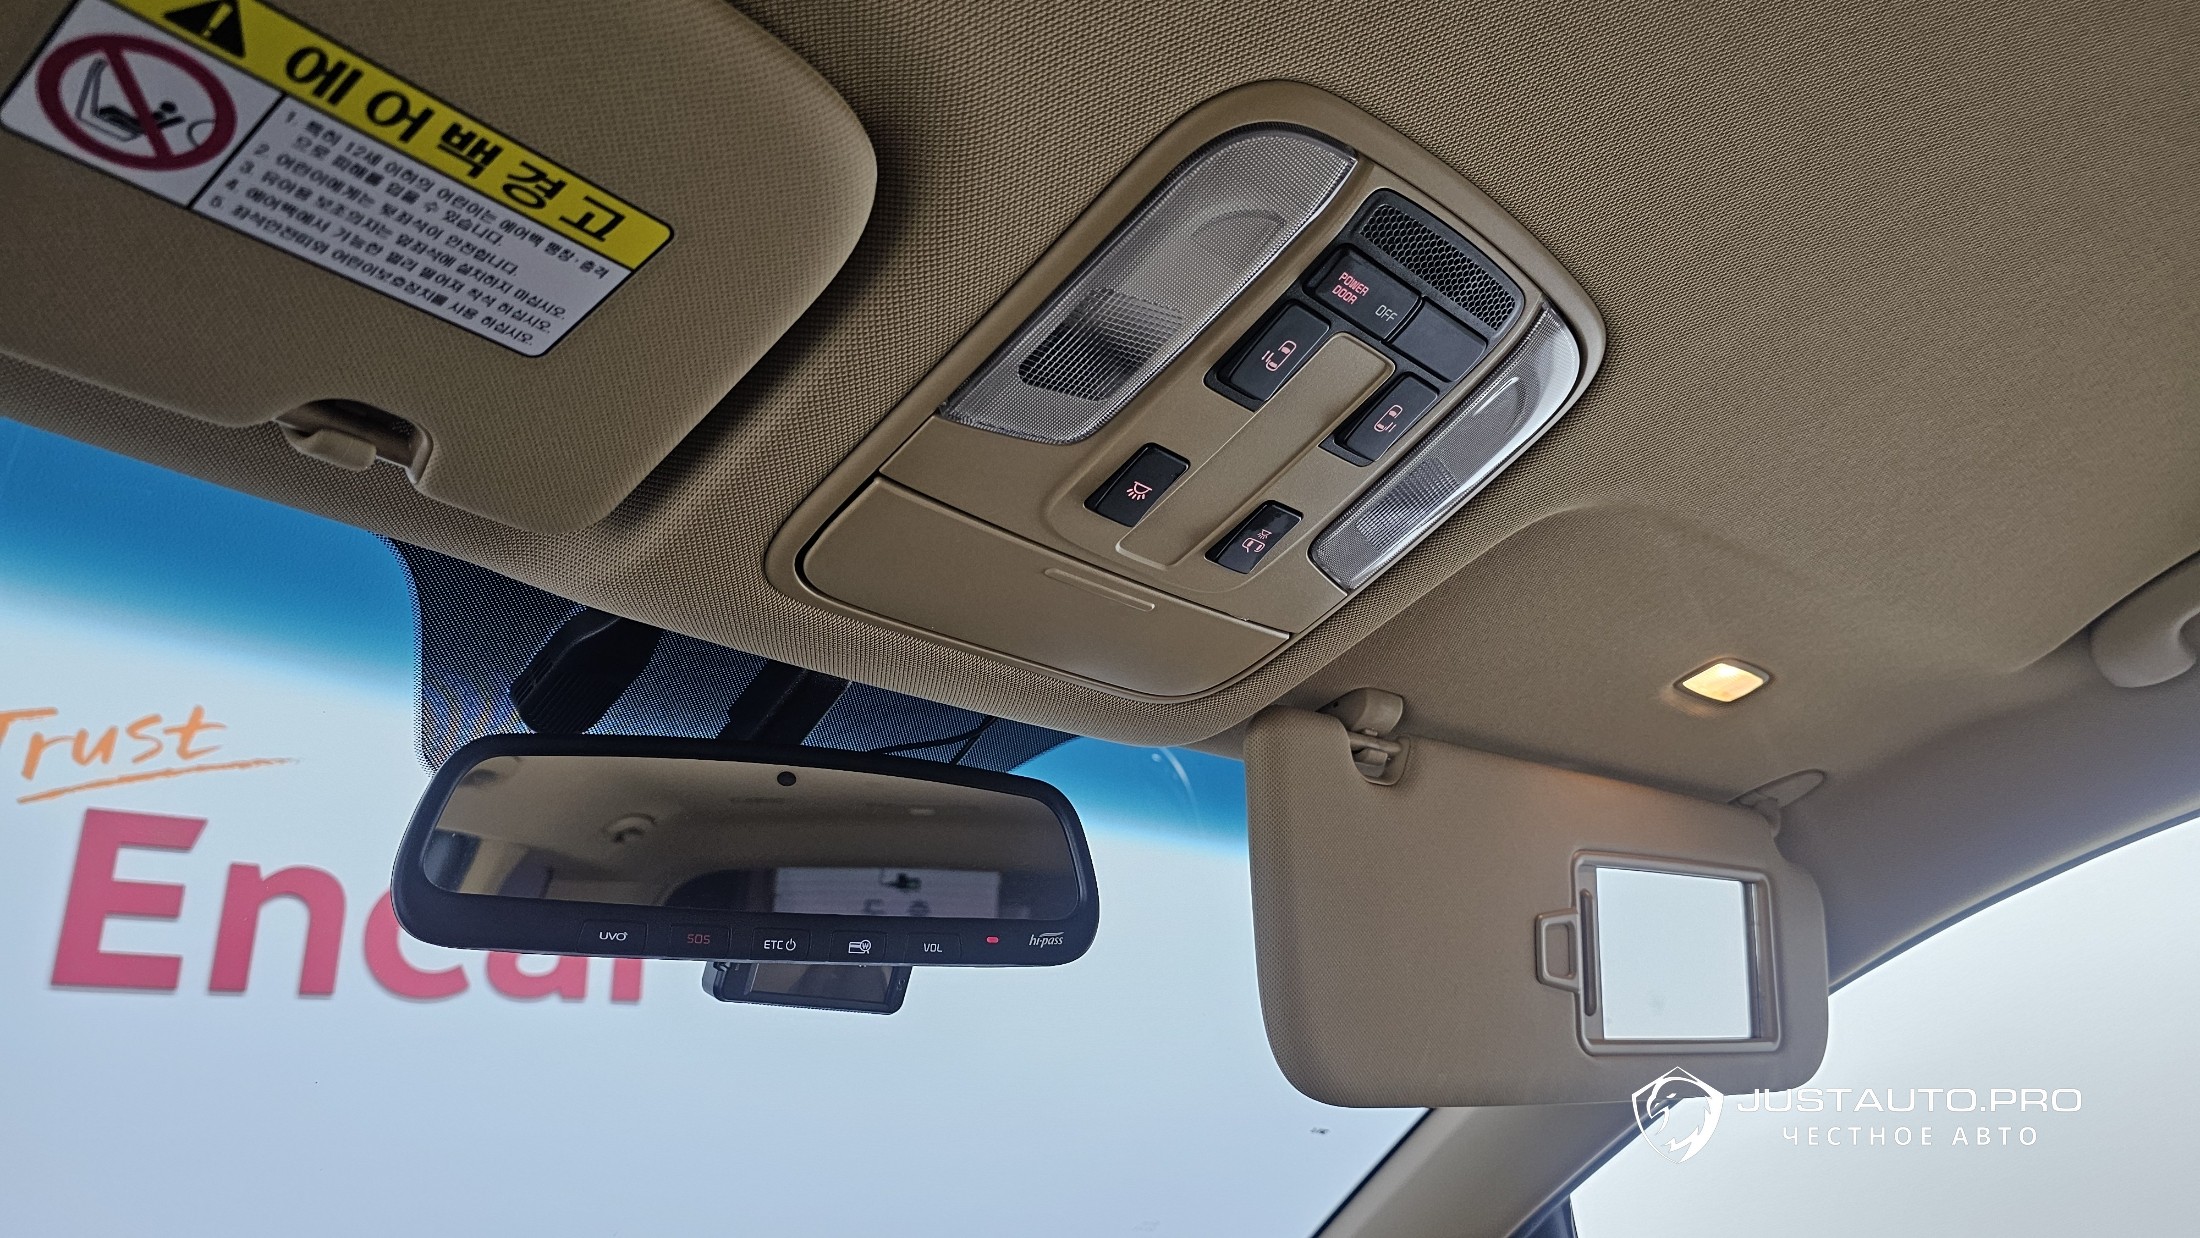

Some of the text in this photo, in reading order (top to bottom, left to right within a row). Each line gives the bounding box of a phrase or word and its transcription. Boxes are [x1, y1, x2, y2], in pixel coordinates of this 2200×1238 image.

[291, 135, 504, 247] 으로 피해를 입을 수 있습니다.
[344, 141, 384, 167] 12세
[383, 160, 435, 193] 이하의
[436, 187, 498, 224] 어린이는
[498, 219, 545, 248] 에어백
[275, 152, 376, 209] 어린이에게는
[443, 234, 519, 276] 안전합니다.
[245, 187, 332, 233] 에어백에서
[331, 225, 384, 257] 가능한
[385, 250, 419, 272] 멀리
[418, 266, 465, 293] 떨어져
[466, 287, 497, 308] 착석
[496, 301, 551, 334] 하십시오.
[395, 232, 457, 268] 앞좌석에
[455, 262, 514, 294] 설치하지
[512, 287, 566, 320] 마십시오.
[1338, 272, 1369, 297] POWER
[330, 248, 449, 307] 어린이보호장치를
[446, 301, 479, 320] 사용
[480, 315, 533, 346] 하십시오.
[1331, 285, 1358, 305] DOOR
[1375, 305, 1398, 322] OFF
[599, 931, 628, 941] UVO
[687, 933, 711, 945] SOS
[763, 940, 784, 950] ETC
[923, 943, 943, 953] VOL
